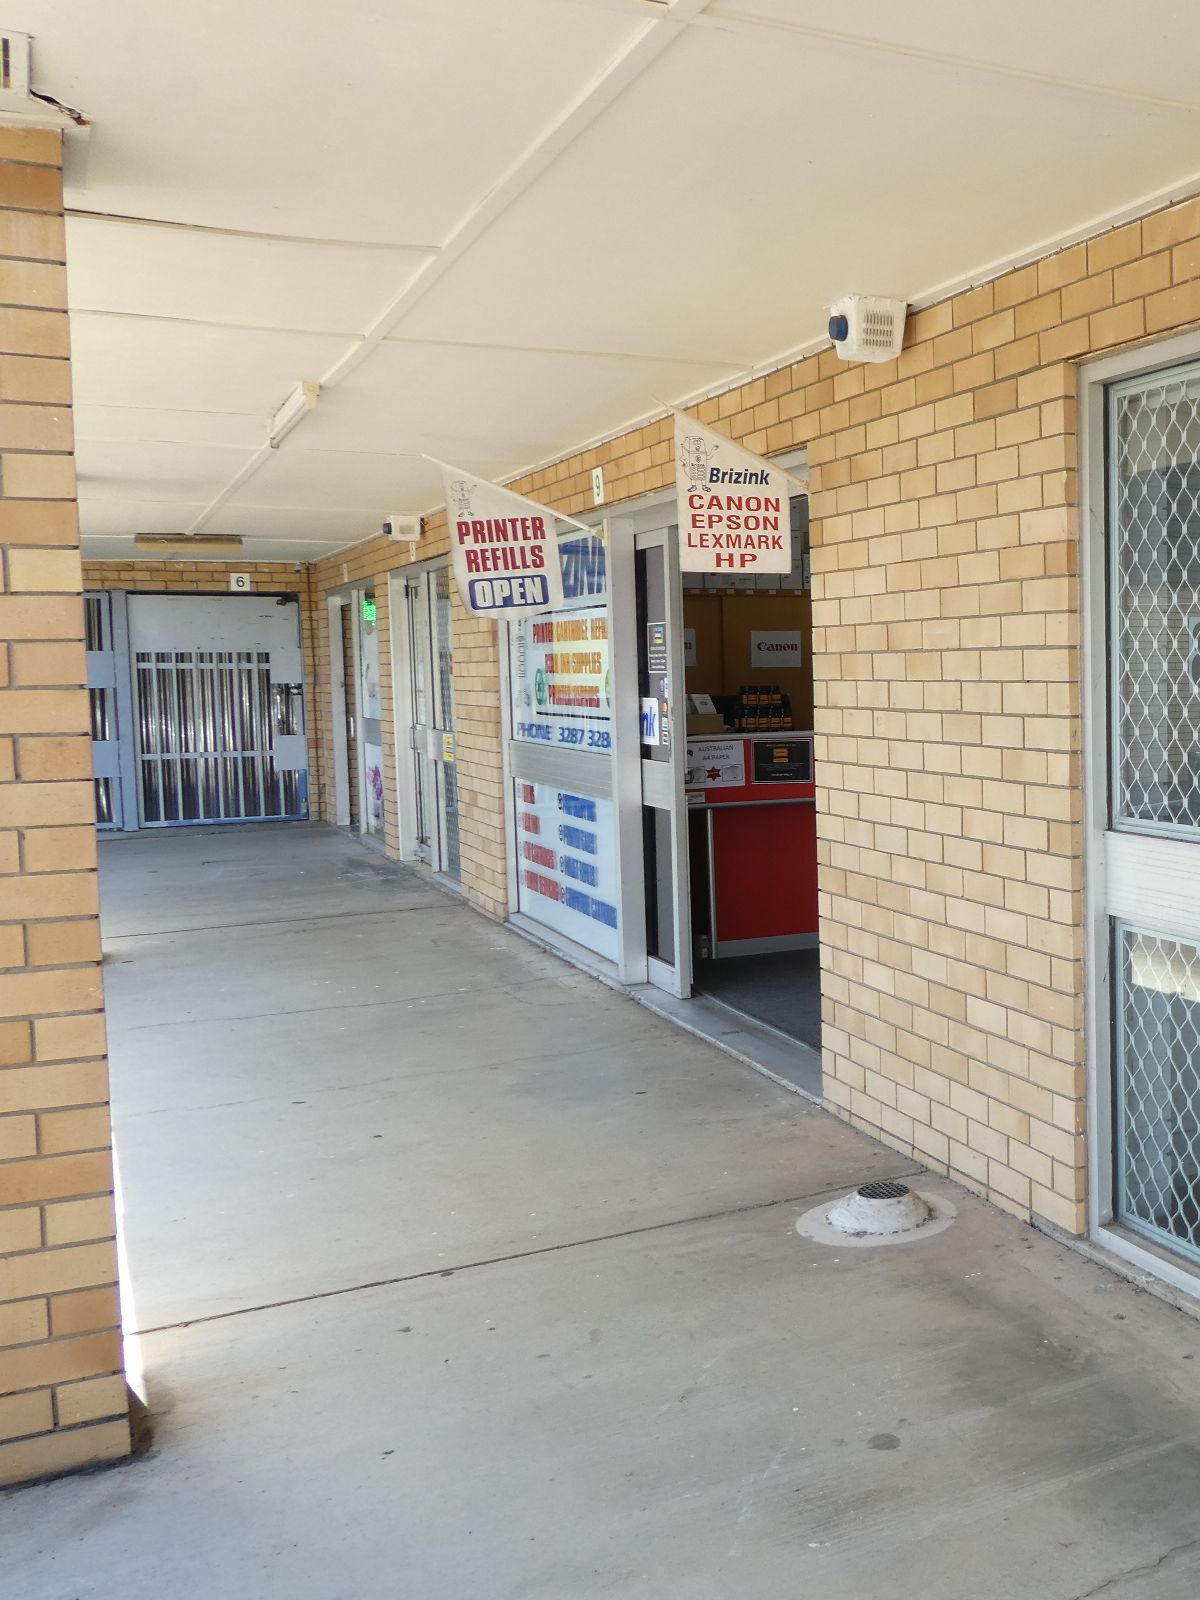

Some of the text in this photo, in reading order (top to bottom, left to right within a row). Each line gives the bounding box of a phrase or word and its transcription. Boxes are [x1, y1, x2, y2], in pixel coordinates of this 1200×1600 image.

[709, 467, 771, 485] Brizink
[688, 494, 781, 513] CANON
[456, 516, 547, 545] PRINTER
[691, 513, 779, 531] EPSON
[687, 533, 784, 550] LEXMARK
[465, 544, 545, 573] REFILLS
[715, 552, 758, 568] HP
[236, 576, 245, 588] 6
[474, 576, 544, 608] OPEN
[757, 641, 798, 652] Canon
[517, 722, 612, 749] PHONE 3287 328
